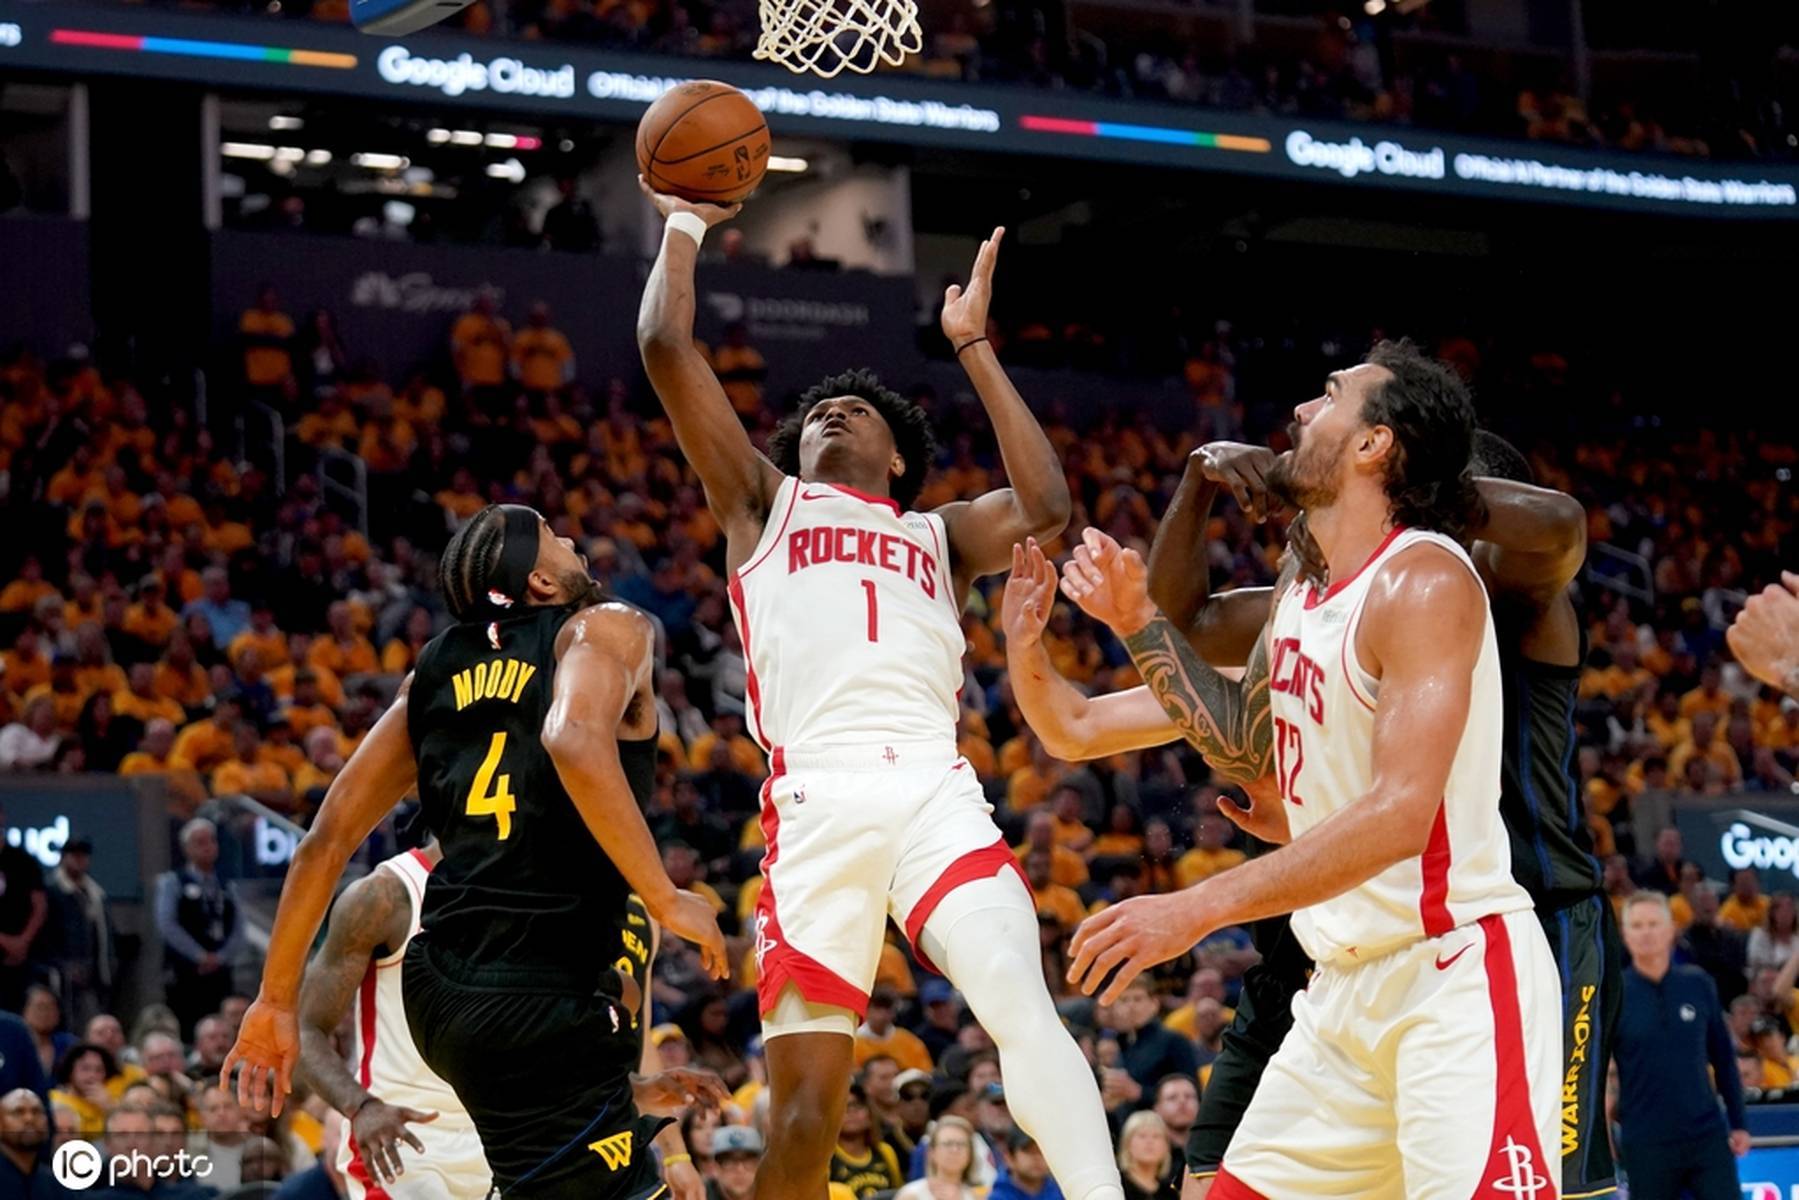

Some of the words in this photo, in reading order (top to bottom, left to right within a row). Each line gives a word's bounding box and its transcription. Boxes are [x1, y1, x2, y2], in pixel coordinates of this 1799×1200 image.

[377, 45, 488, 97] Google
[487, 57, 575, 98] Cloud
[807, 90, 875, 120] Golden
[921, 100, 1000, 132] Warriors
[1285, 130, 1376, 178] Google
[1374, 140, 1445, 179] Cloud
[1629, 171, 1683, 200] Golden
[1720, 180, 1797, 205] Warriors
[788, 526, 937, 600] ROCKETS
[861, 579, 879, 643] 1
[452, 657, 537, 712] MOODY
[466, 732, 517, 841] 4
[1275, 717, 1304, 806] 12
